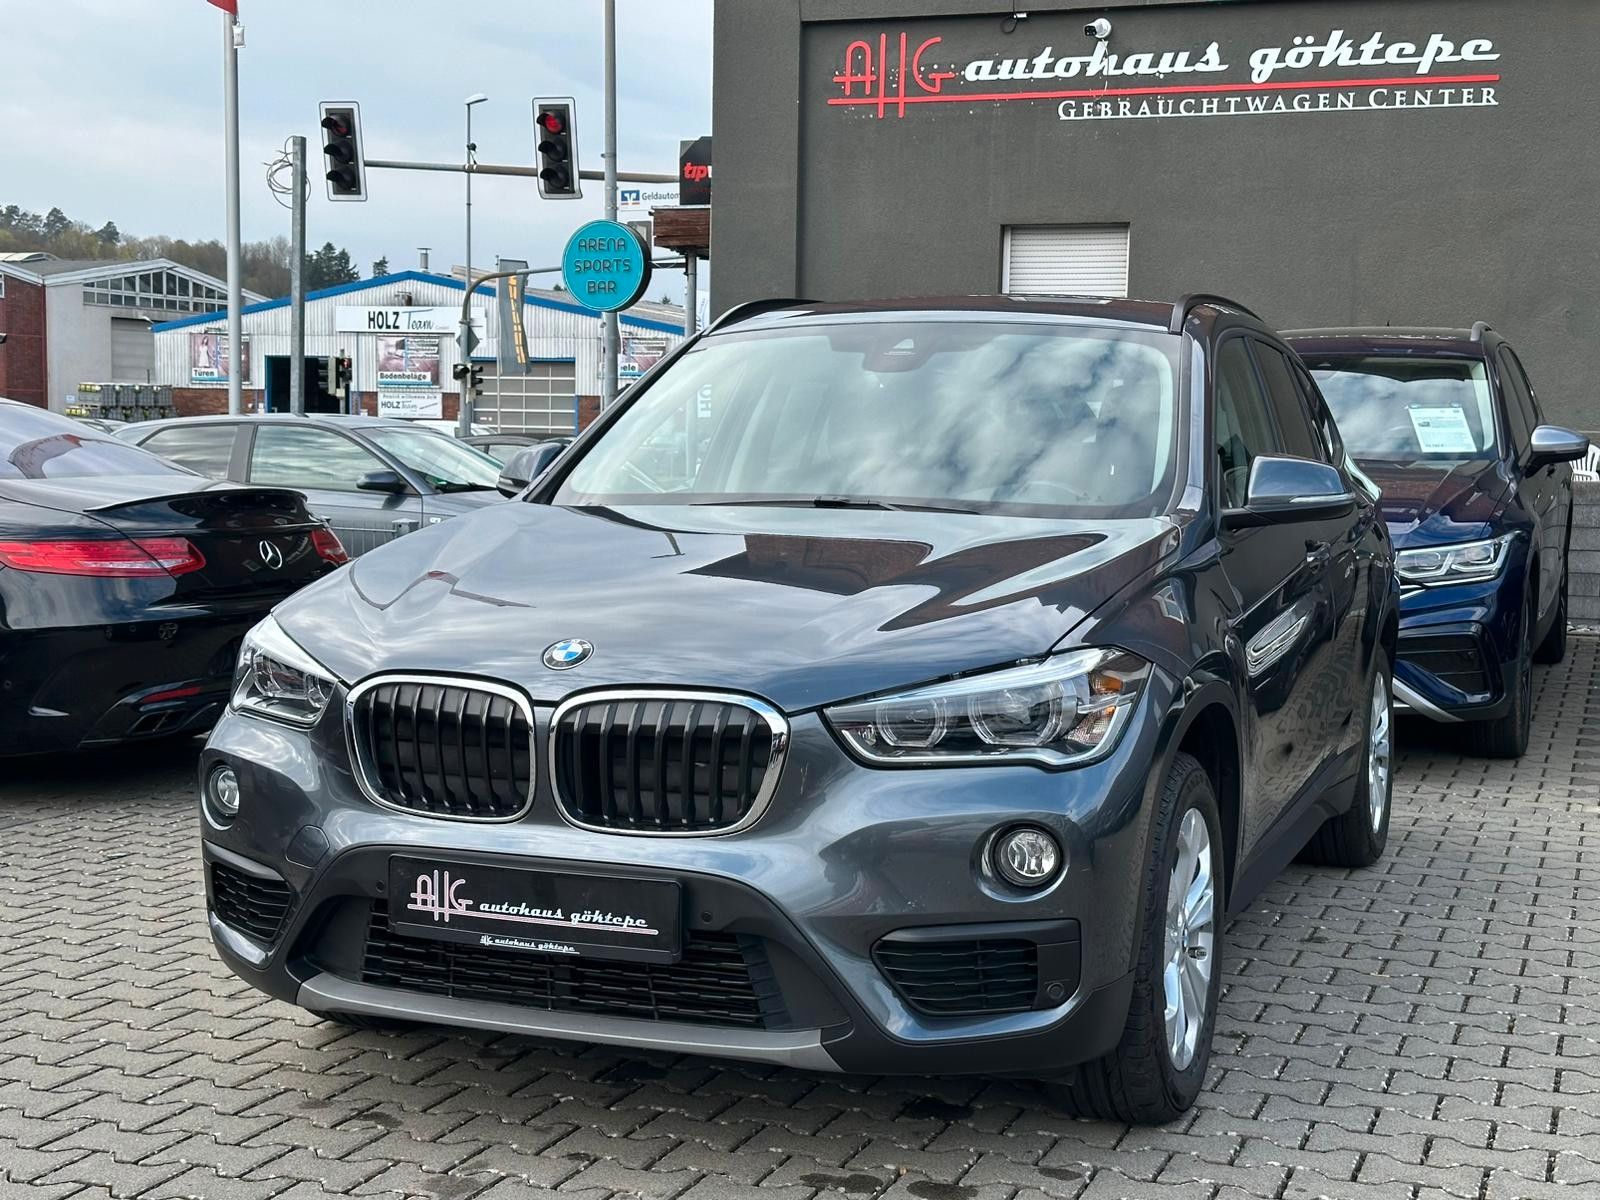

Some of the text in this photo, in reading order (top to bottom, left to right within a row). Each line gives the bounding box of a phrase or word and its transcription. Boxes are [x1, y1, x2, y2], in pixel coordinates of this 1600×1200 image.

[965, 40, 1229, 82] autohaus
[1249, 29, 1500, 84] göktepe
[1368, 87, 1499, 108] CENTER
[684, 162, 712, 182] tip
[641, 192, 680, 201] Geldautom
[578, 237, 626, 252] ARENA
[574, 259, 632, 273] SPORTS
[587, 280, 617, 294] BAR
[368, 308, 434, 330] HOLZ Team
[381, 401, 400, 409] HOLZ
[479, 902, 564, 920] autohaus
[570, 909, 648, 929] göktepe
[494, 937, 536, 948] autohaus
[537, 942, 576, 953] göktepe
